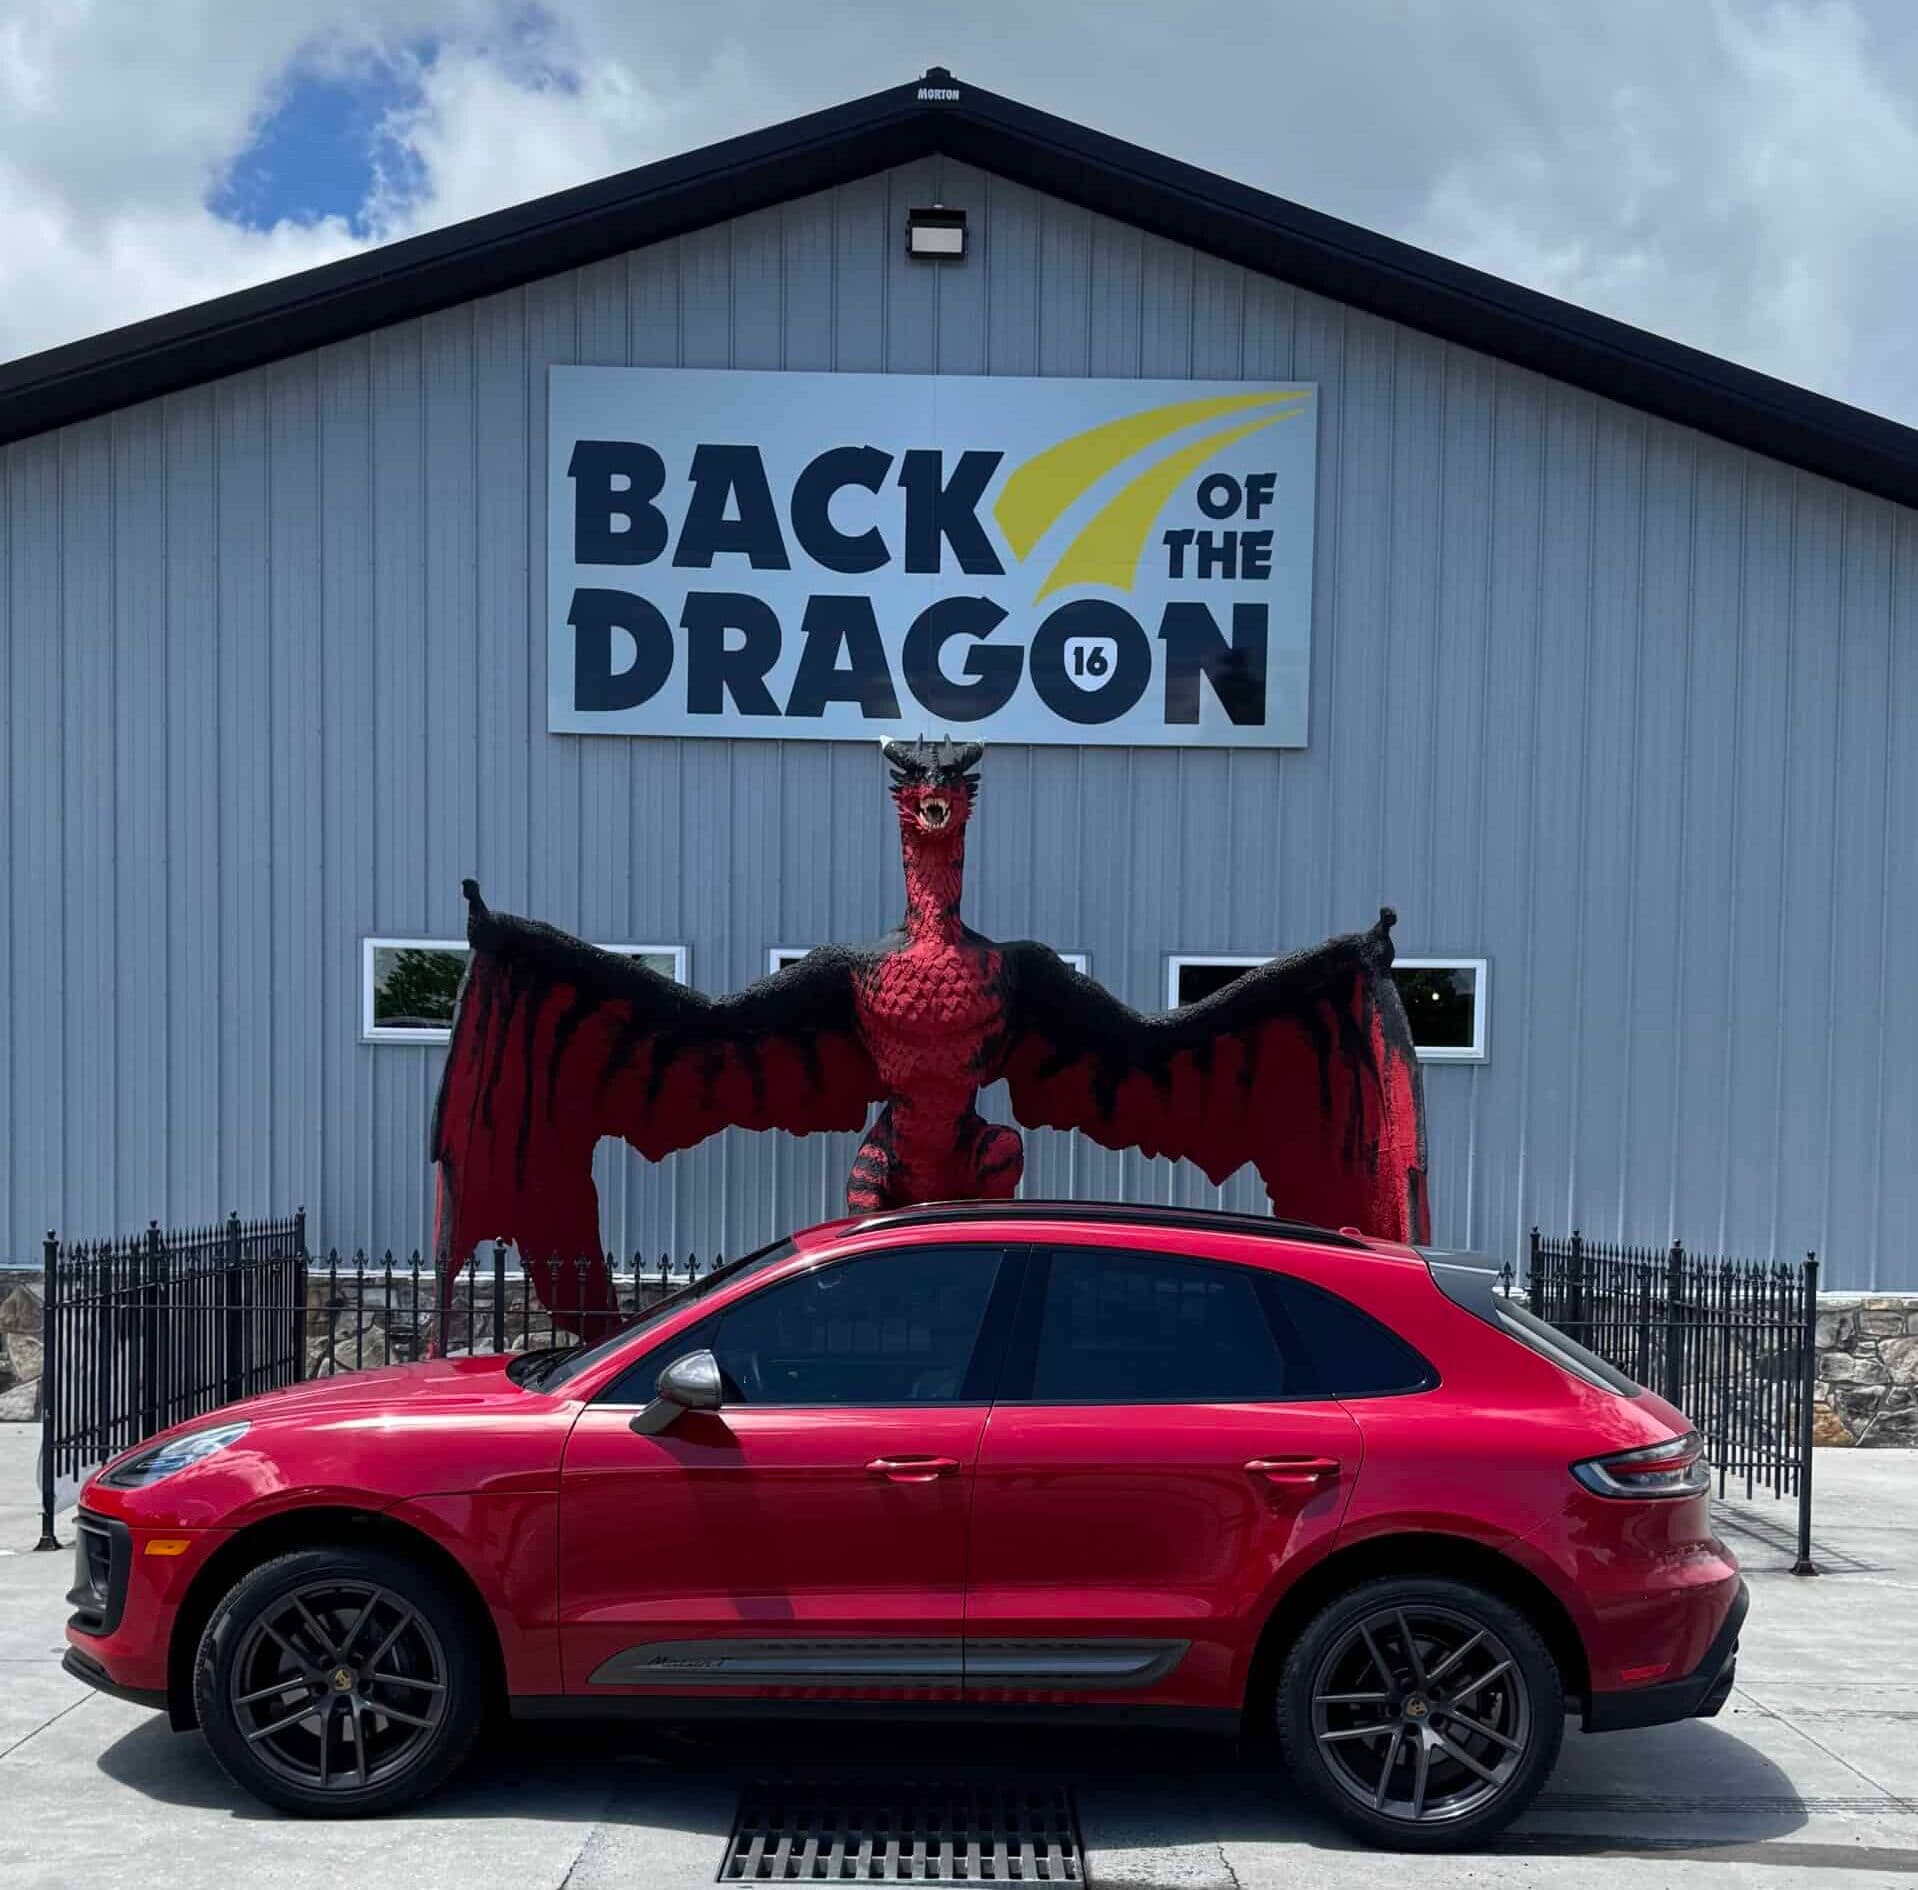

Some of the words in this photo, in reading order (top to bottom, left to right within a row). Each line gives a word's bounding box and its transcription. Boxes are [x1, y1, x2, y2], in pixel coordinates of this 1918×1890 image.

[917, 87, 960, 101] MORTON
[567, 440, 1005, 576] BACK
[1196, 473, 1278, 520] OF
[1162, 529, 1275, 580] THE
[566, 588, 1269, 727] DRAGON
[1073, 646, 1108, 677] 16
